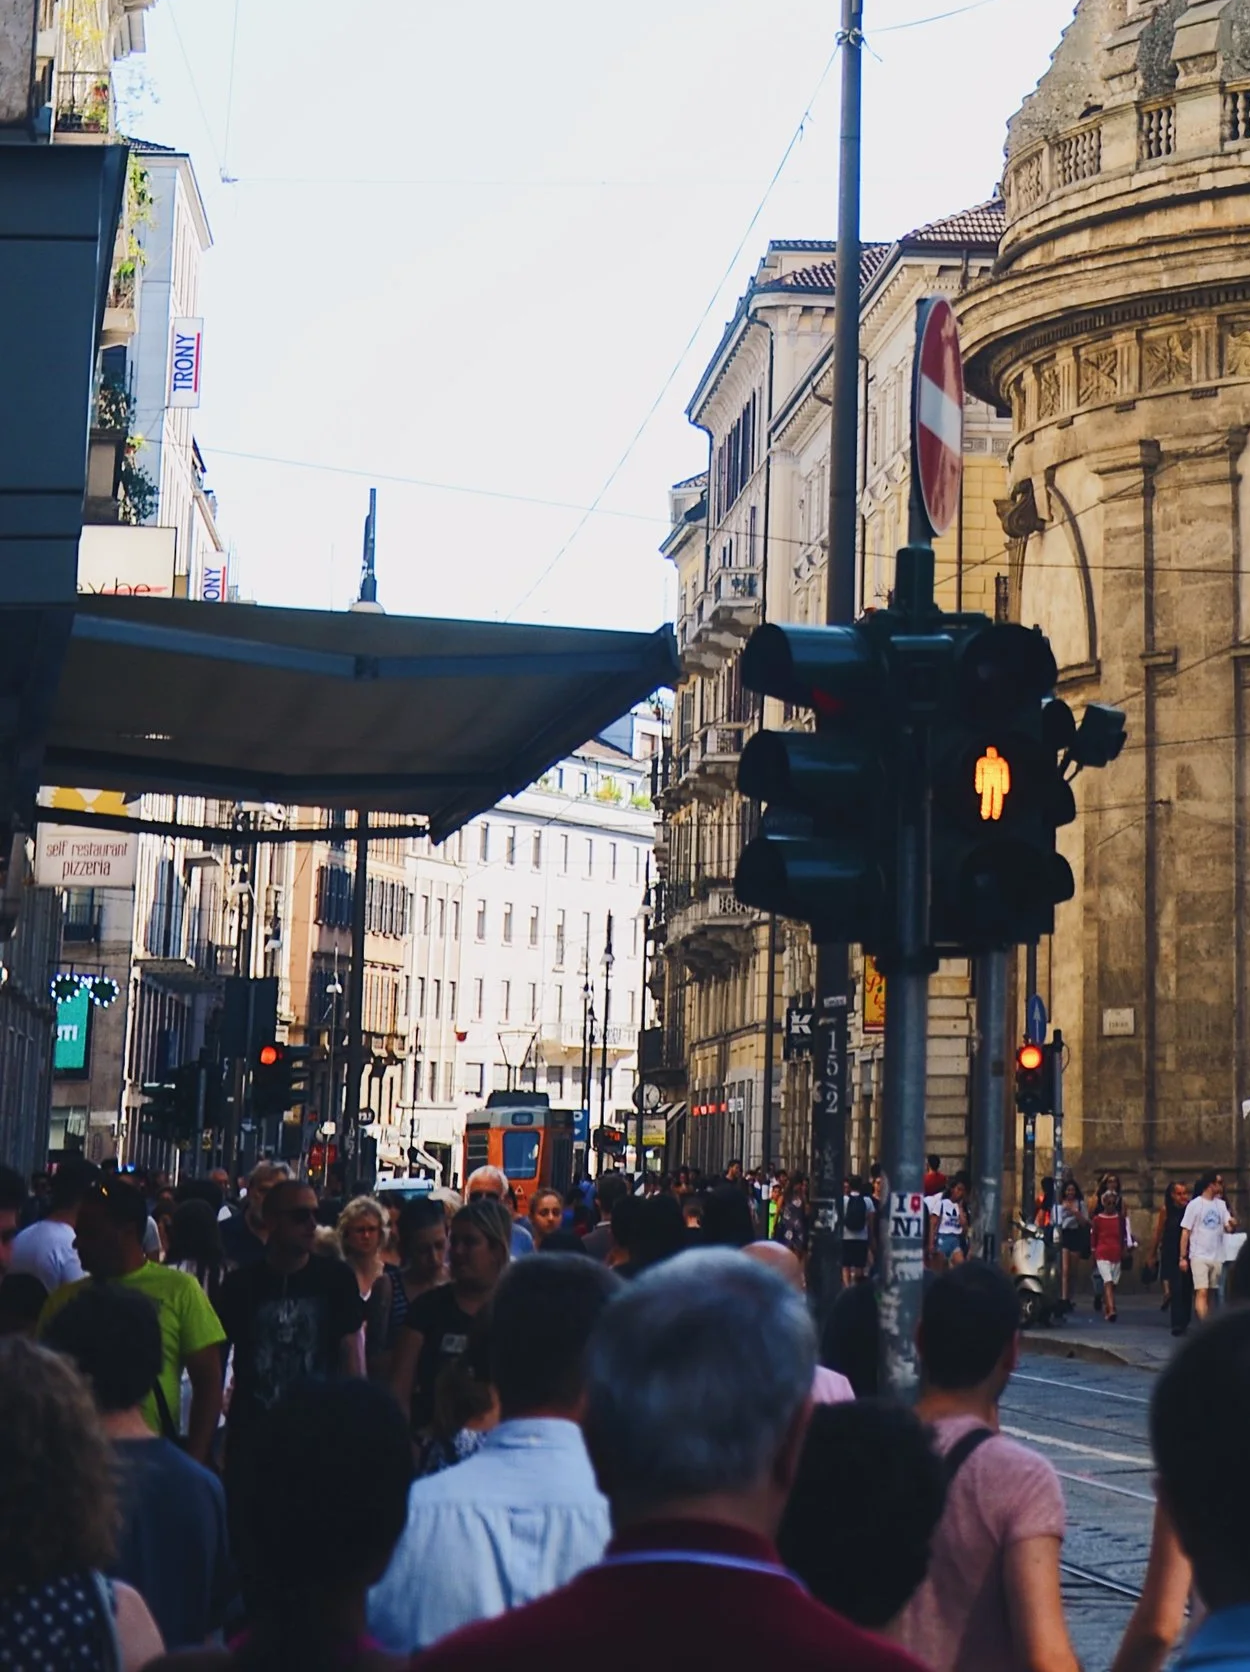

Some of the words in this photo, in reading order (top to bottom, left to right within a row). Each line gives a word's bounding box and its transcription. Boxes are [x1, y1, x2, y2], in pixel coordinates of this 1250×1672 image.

[173, 333, 195, 392] TRONY
[203, 566, 220, 601] ONY
[46, 840, 68, 856] self
[71, 842, 128, 857] restaurant
[62, 860, 111, 880] pizzeria
